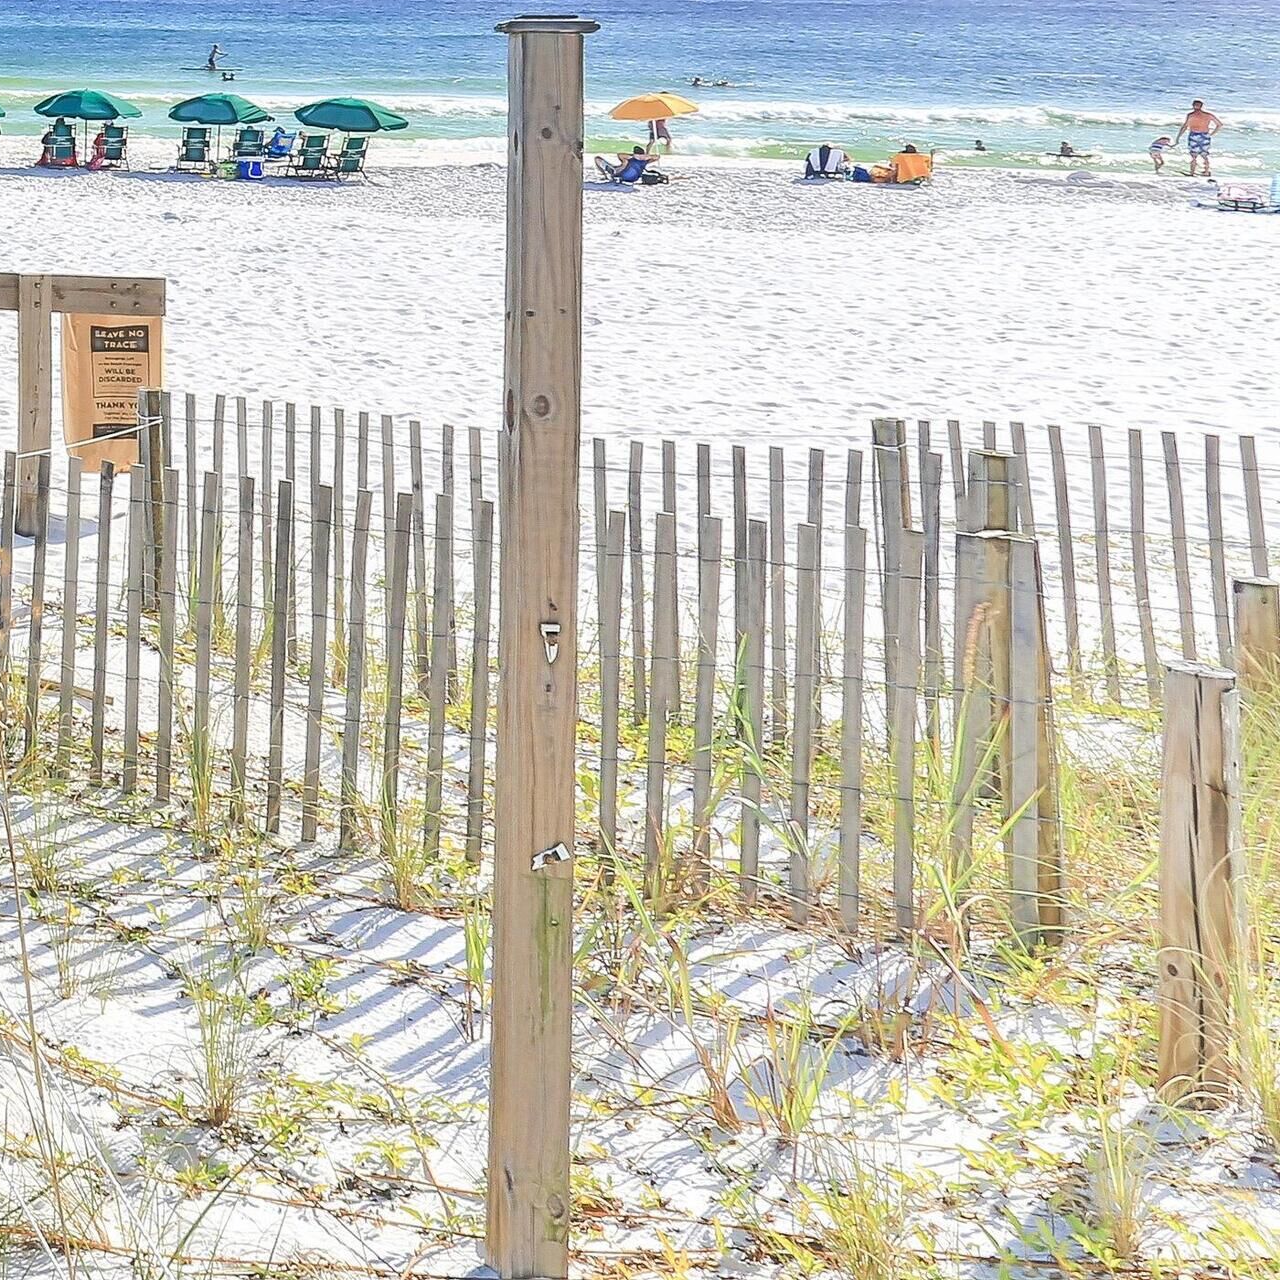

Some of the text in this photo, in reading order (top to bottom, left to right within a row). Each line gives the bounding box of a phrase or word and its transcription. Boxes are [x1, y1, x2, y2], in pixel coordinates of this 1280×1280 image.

[95, 330, 145, 339] LEAVE NO
[104, 340, 138, 349] TRACE
